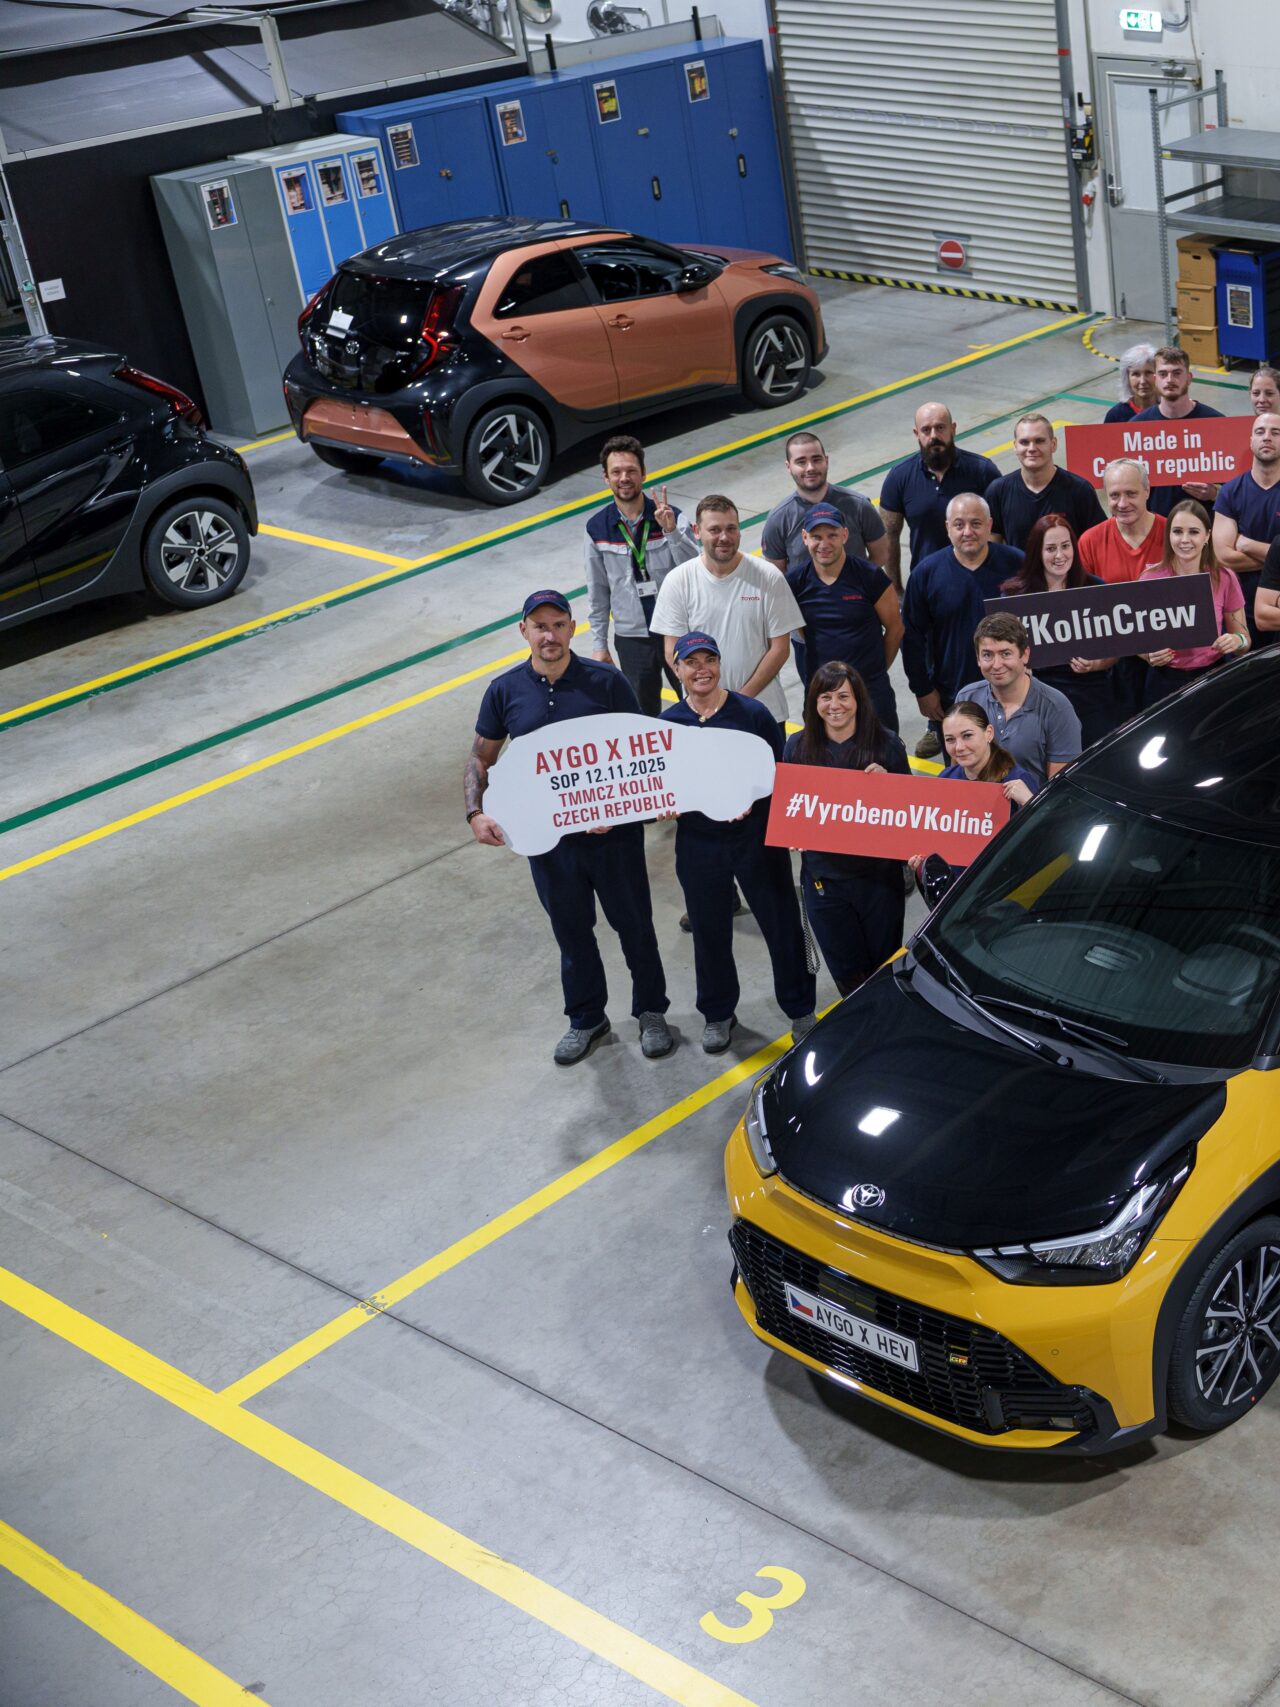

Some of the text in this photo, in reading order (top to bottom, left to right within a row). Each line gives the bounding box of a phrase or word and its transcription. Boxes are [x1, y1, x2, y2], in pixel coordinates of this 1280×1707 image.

[1123, 429, 1201, 452] Made in
[1156, 451, 1235, 478] republic
[536, 728, 673, 775] AYGO X HEV
[550, 756, 666, 791] SOP 12.11.2025
[558, 775, 664, 808] TMMCZ KOLÍN
[552, 792, 676, 828] CZECH REPUBLIC
[785, 792, 994, 837] #VyrobenoVKolíně
[816, 1305, 909, 1362] AYGO X HEV
[698, 1565, 807, 1645] 3
